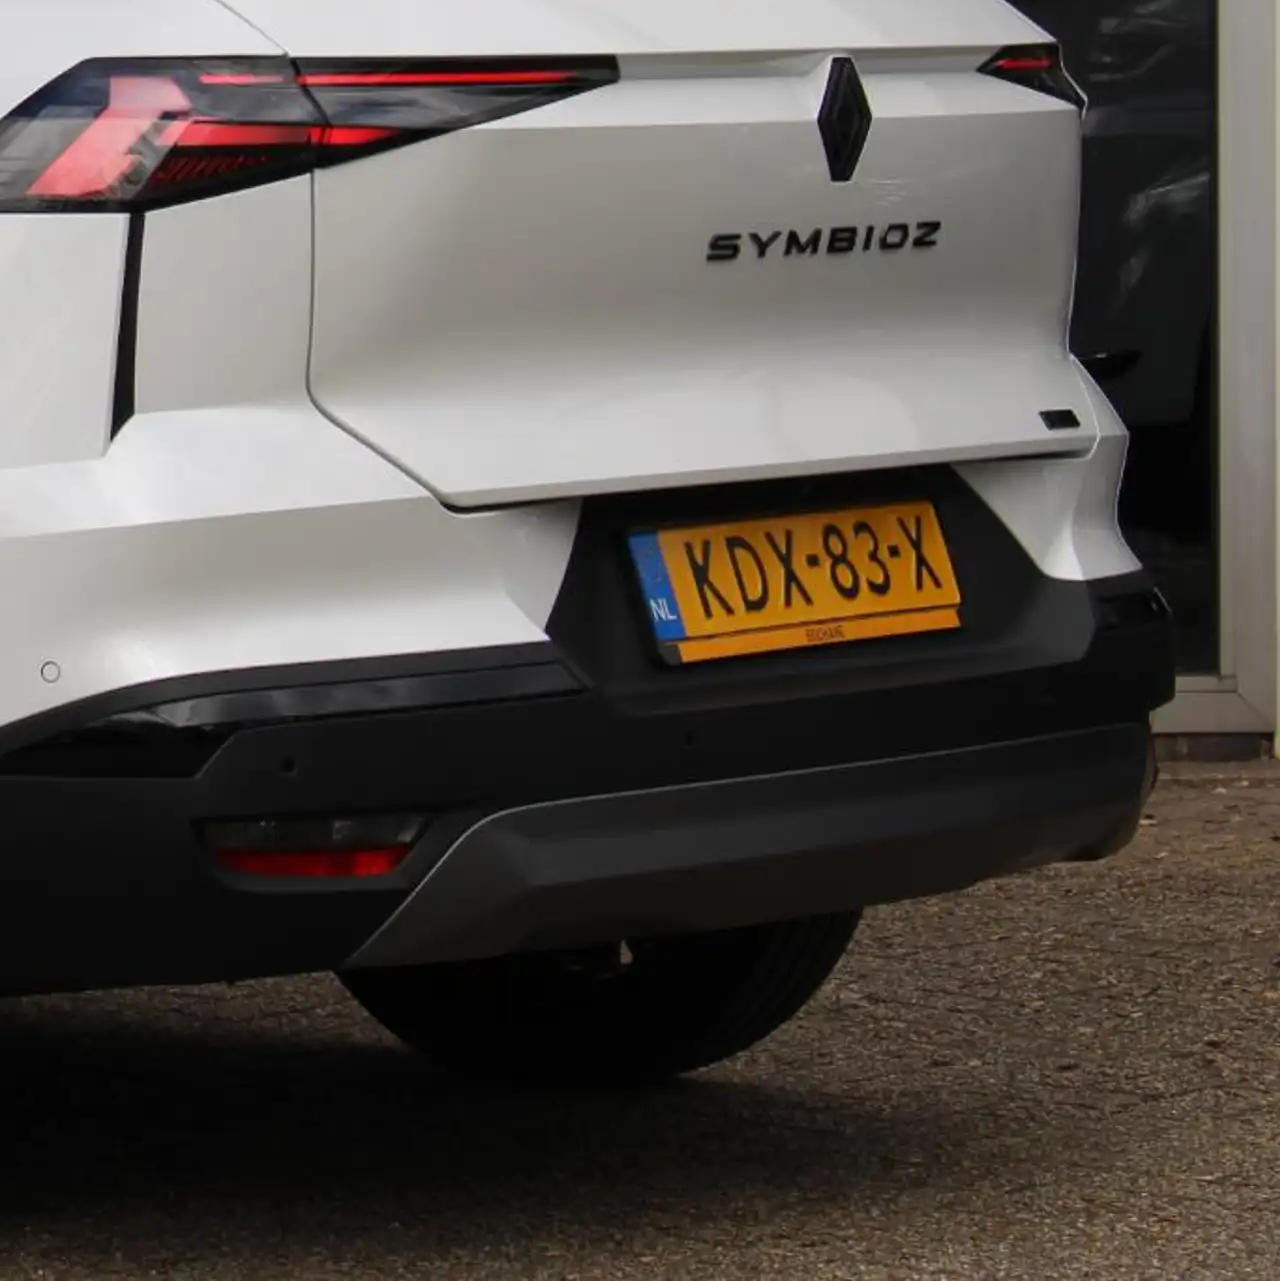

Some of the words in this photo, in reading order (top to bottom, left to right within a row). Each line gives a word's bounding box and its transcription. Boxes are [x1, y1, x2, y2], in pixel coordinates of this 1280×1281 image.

[706, 221, 942, 262] SYMBIOZ
[684, 515, 943, 620] KDX-83-X
[650, 598, 677, 621] NL
